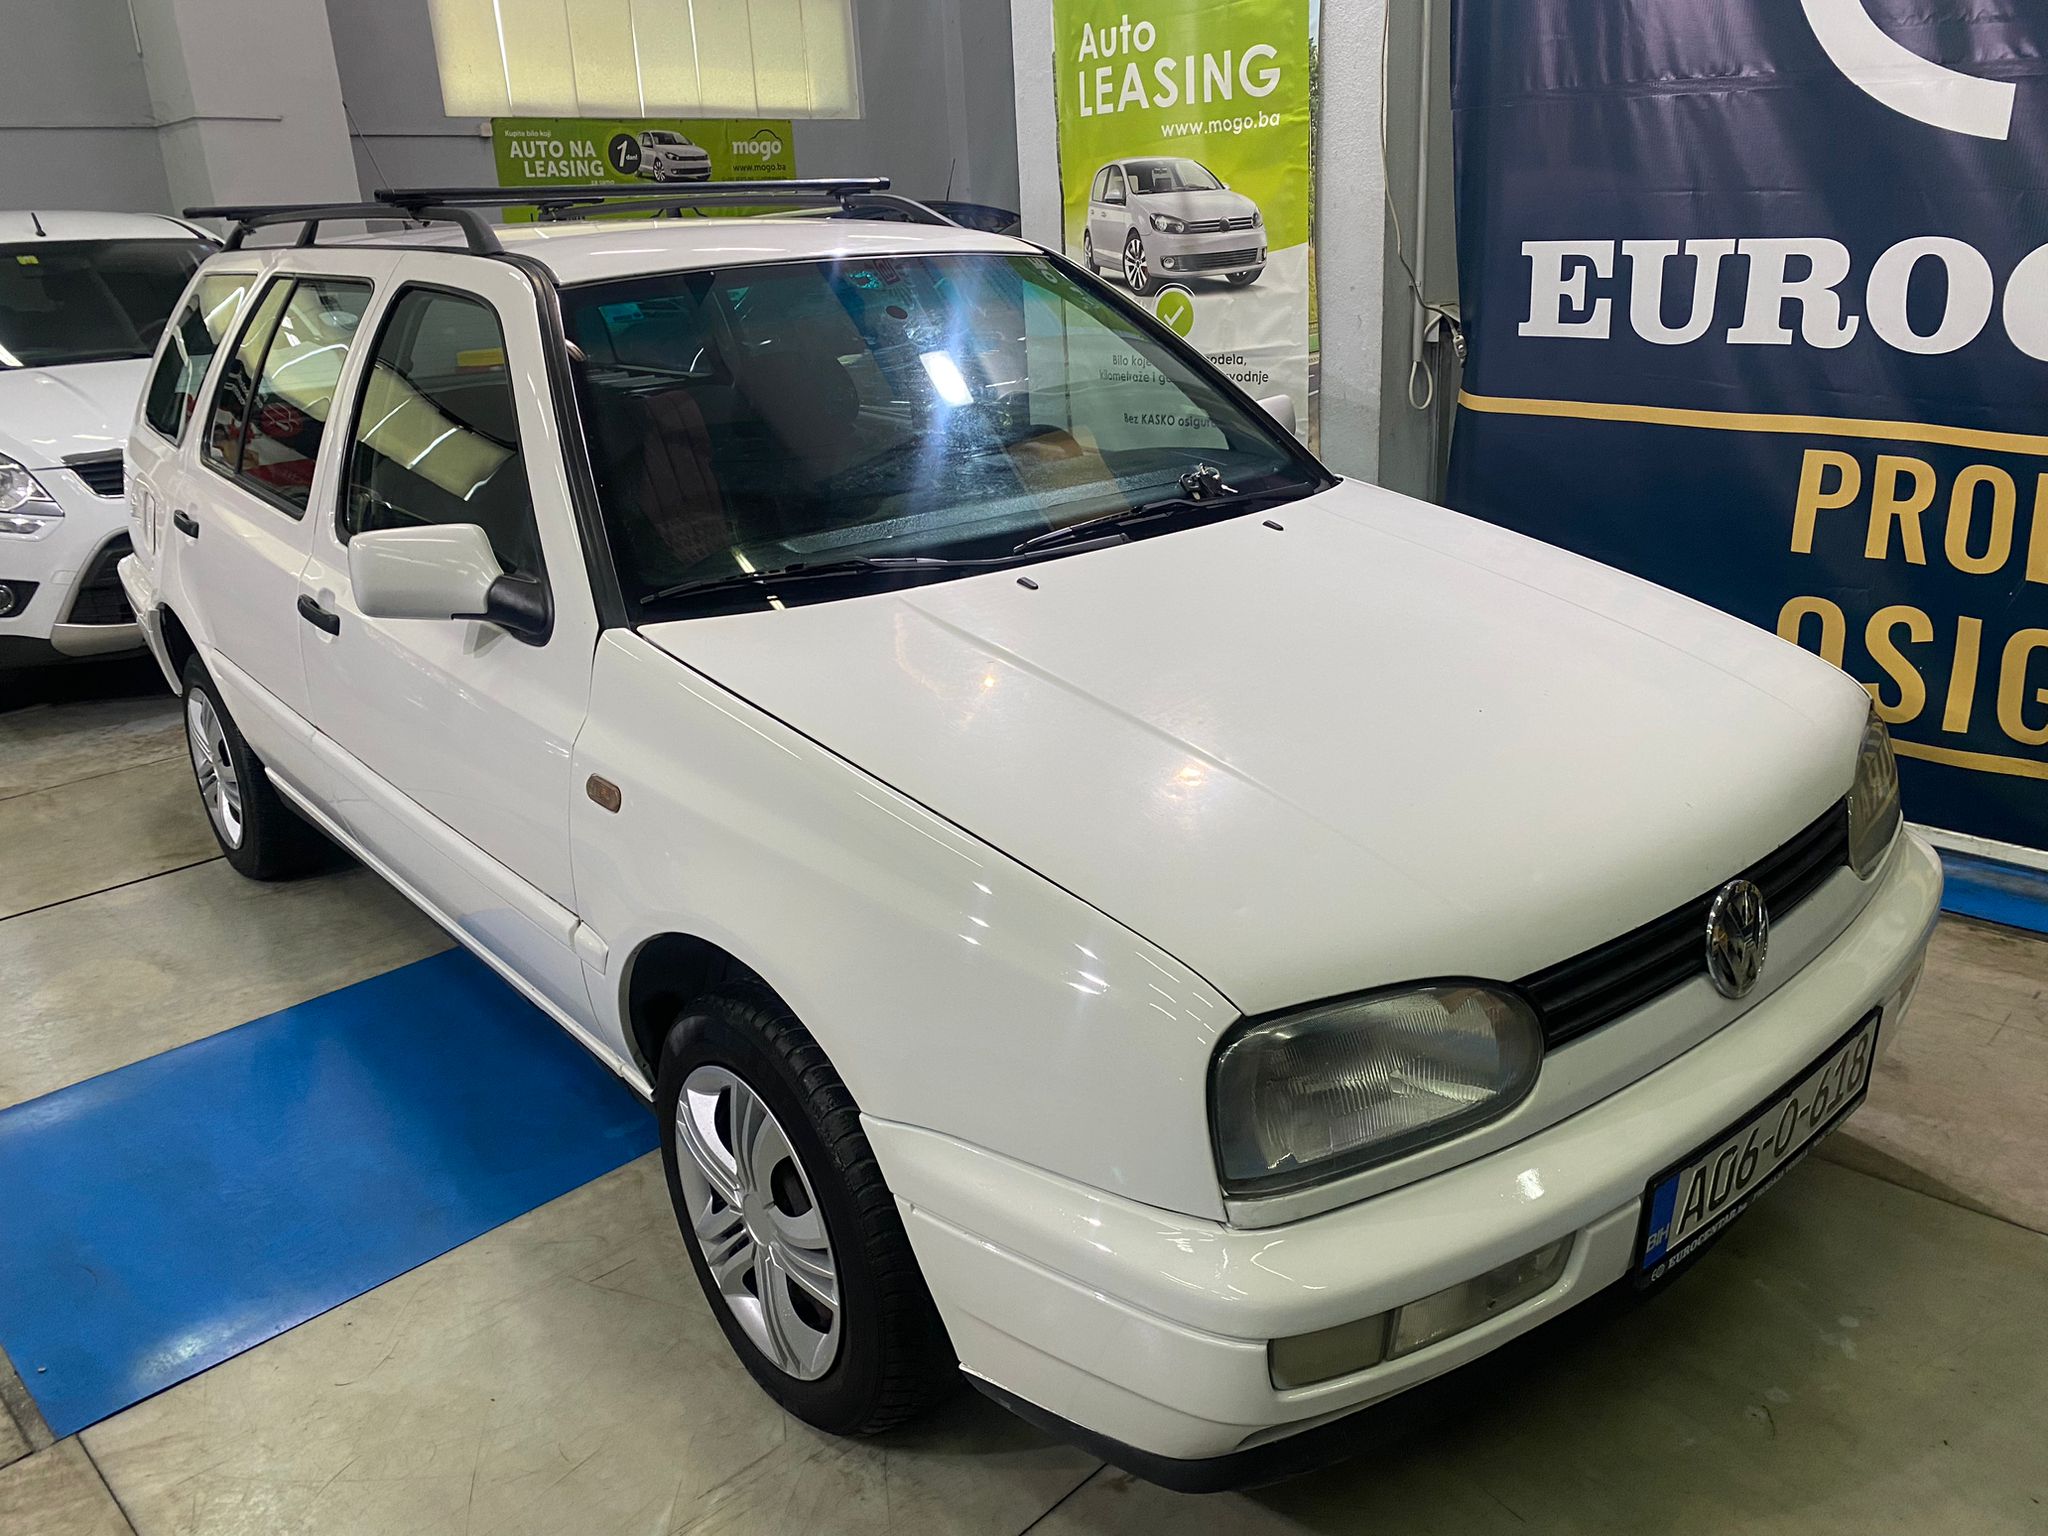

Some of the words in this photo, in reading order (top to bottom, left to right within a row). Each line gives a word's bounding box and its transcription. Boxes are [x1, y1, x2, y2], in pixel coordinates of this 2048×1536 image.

[1078, 14, 1156, 62] Auto
[1078, 44, 1281, 117] LEASING
[1161, 111, 1280, 137] www.mogo.ba
[510, 140, 564, 158] AUTO
[569, 140, 597, 158] NA
[617, 140, 628, 168] 1
[732, 141, 782, 161] mogo
[523, 160, 605, 178] LEASING
[733, 163, 786, 173] www.mogo.ba
[1112, 354, 1128, 366] Bilo
[1141, 413, 1175, 426] KASKO
[1646, 1224, 1670, 1254] BIH
